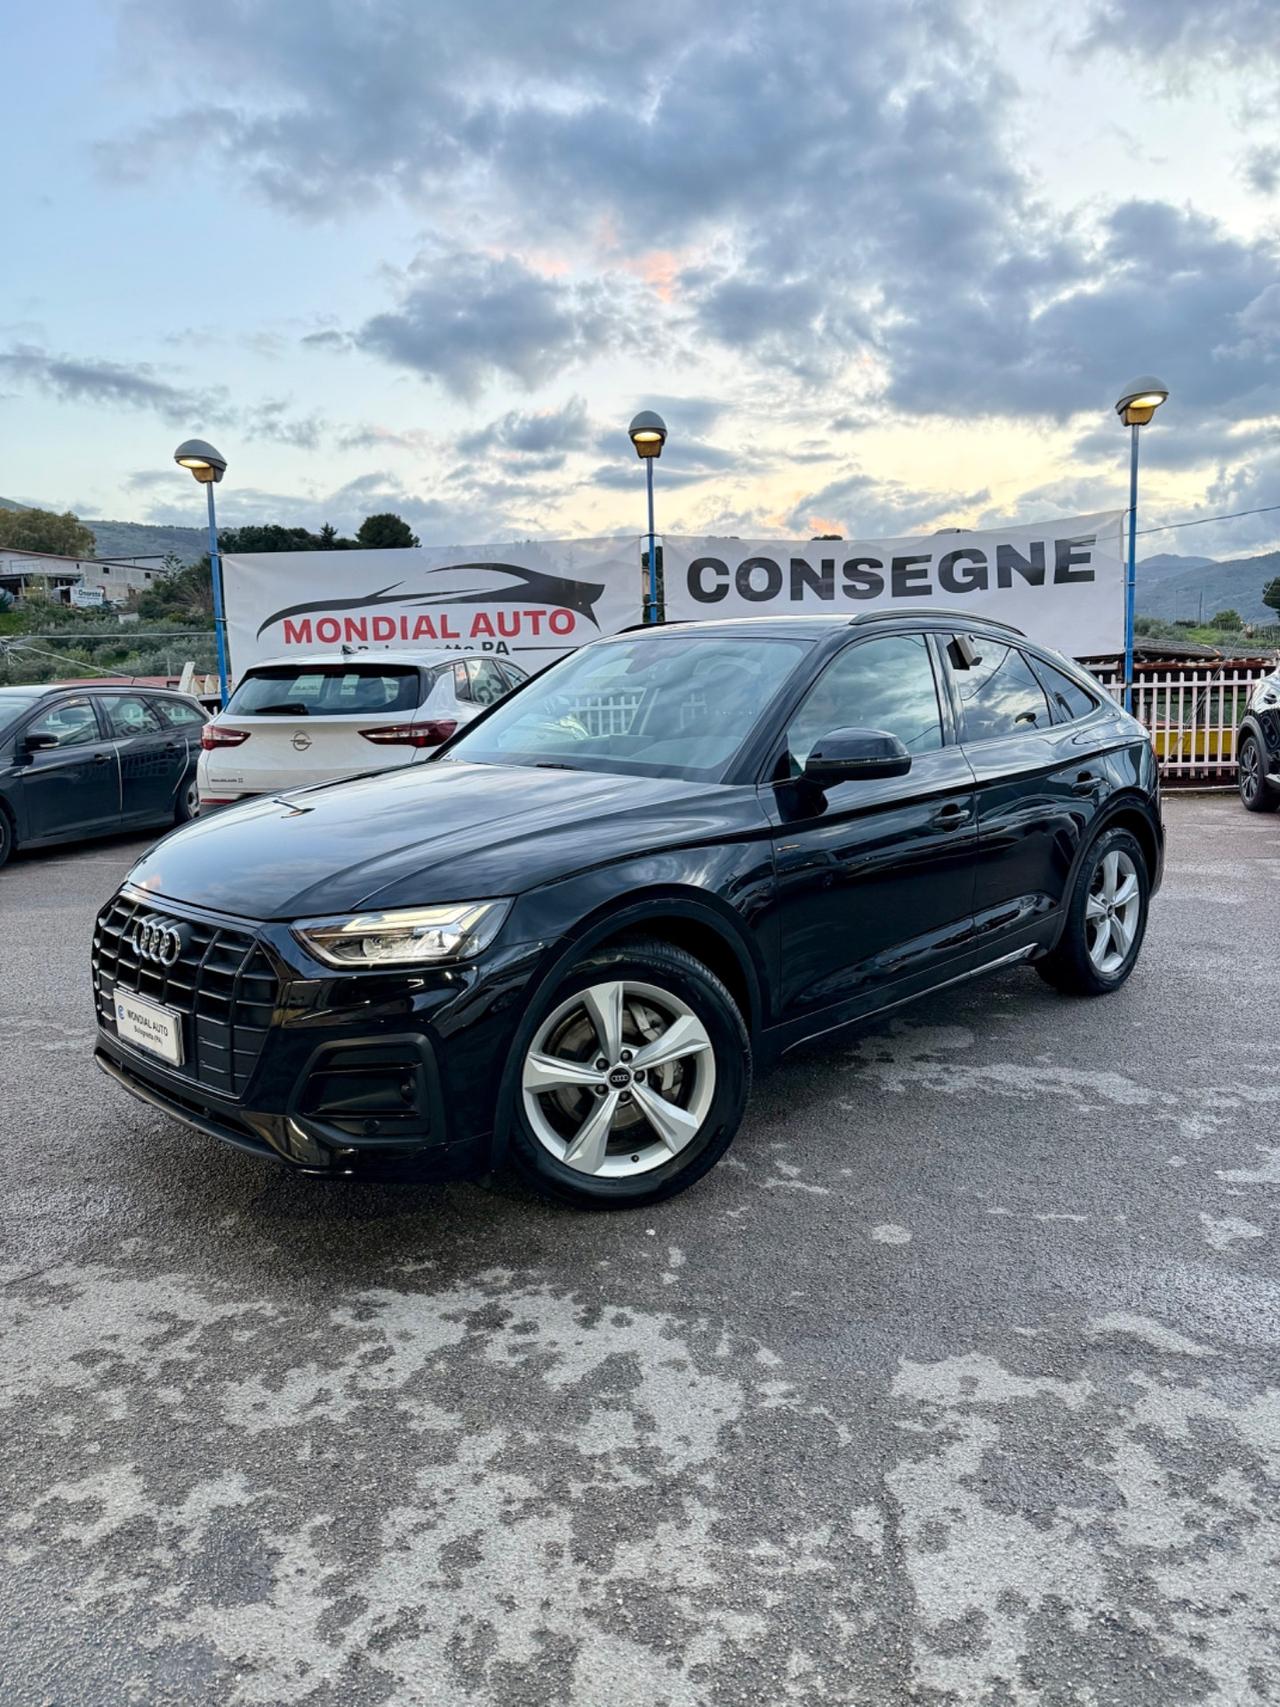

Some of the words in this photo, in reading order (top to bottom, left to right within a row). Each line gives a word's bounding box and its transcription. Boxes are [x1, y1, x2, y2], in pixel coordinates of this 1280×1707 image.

[686, 534, 1098, 603] CONSEGNE
[283, 615, 460, 644] MONDIAL
[469, 609, 576, 638] AUTO
[481, 640, 510, 655] PA
[127, 1010, 152, 1029] MONDIAL
[152, 1021, 169, 1037] AUTO
